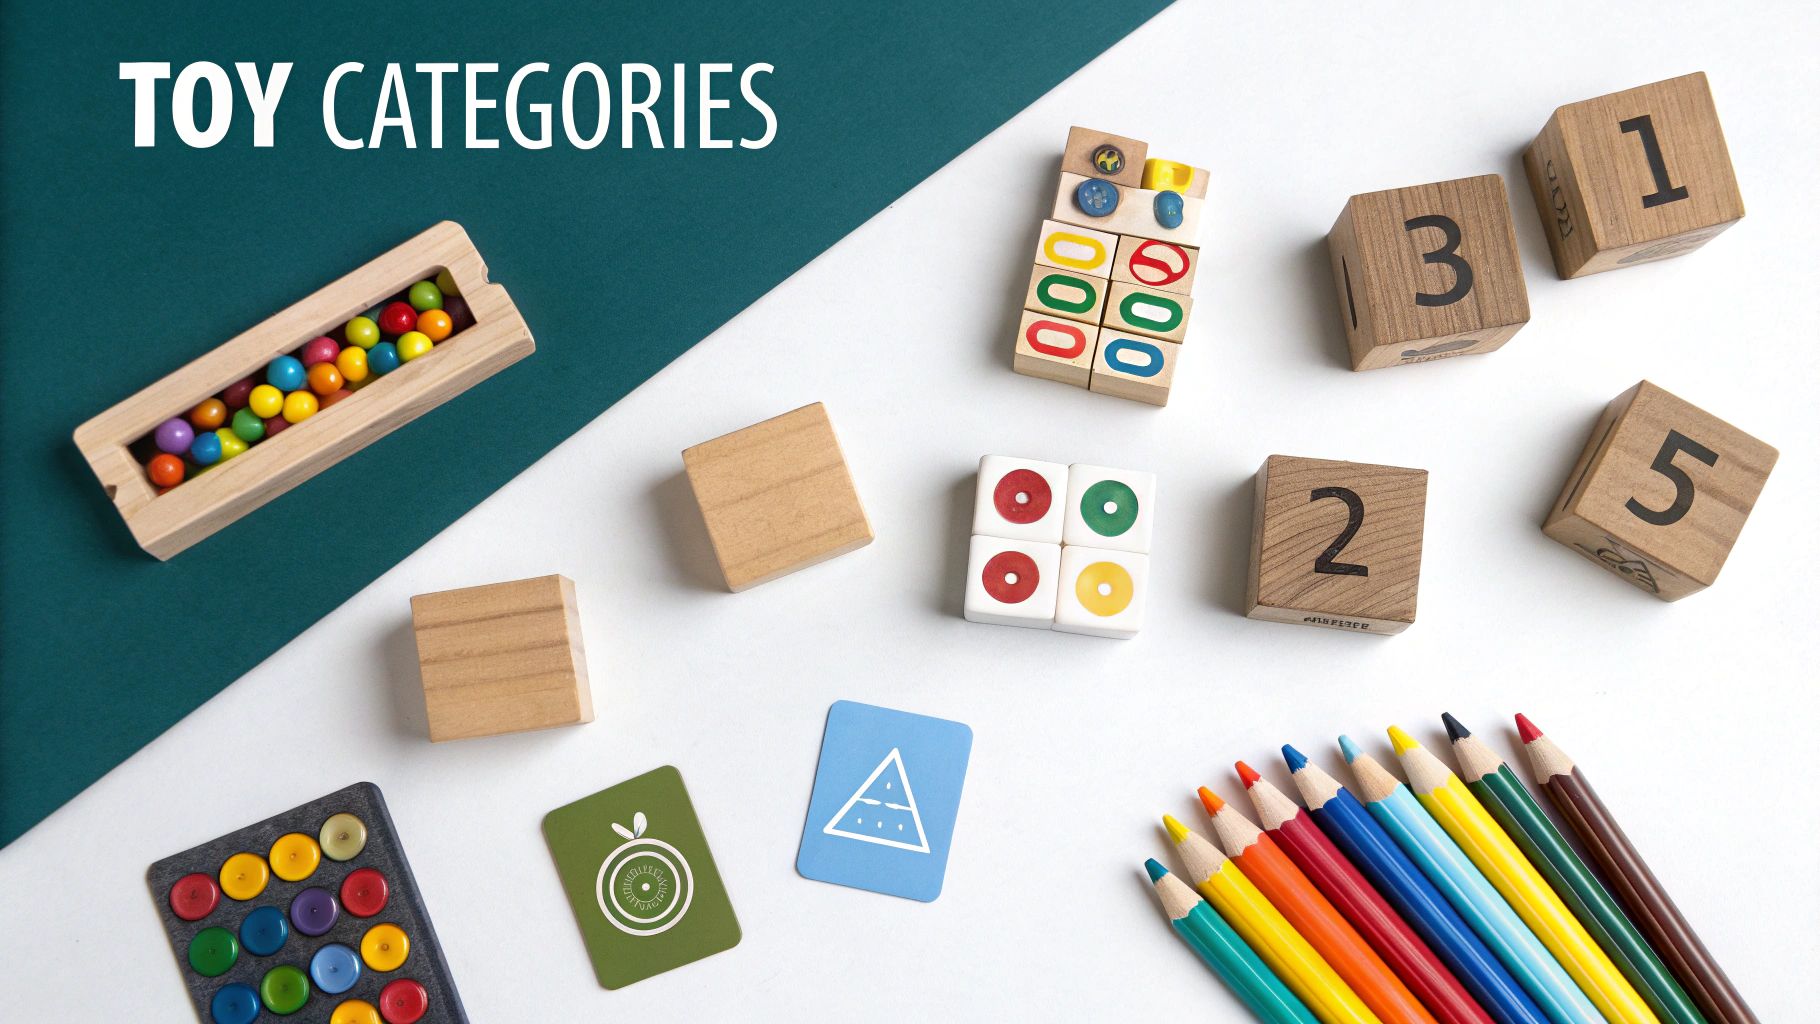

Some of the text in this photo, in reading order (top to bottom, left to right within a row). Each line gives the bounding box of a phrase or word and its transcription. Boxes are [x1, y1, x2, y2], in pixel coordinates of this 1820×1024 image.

[1618, 114, 1689, 209] 1
[1403, 214, 1474, 307] 3
[1624, 429, 1719, 526] 5
[1309, 486, 1369, 578] 2
